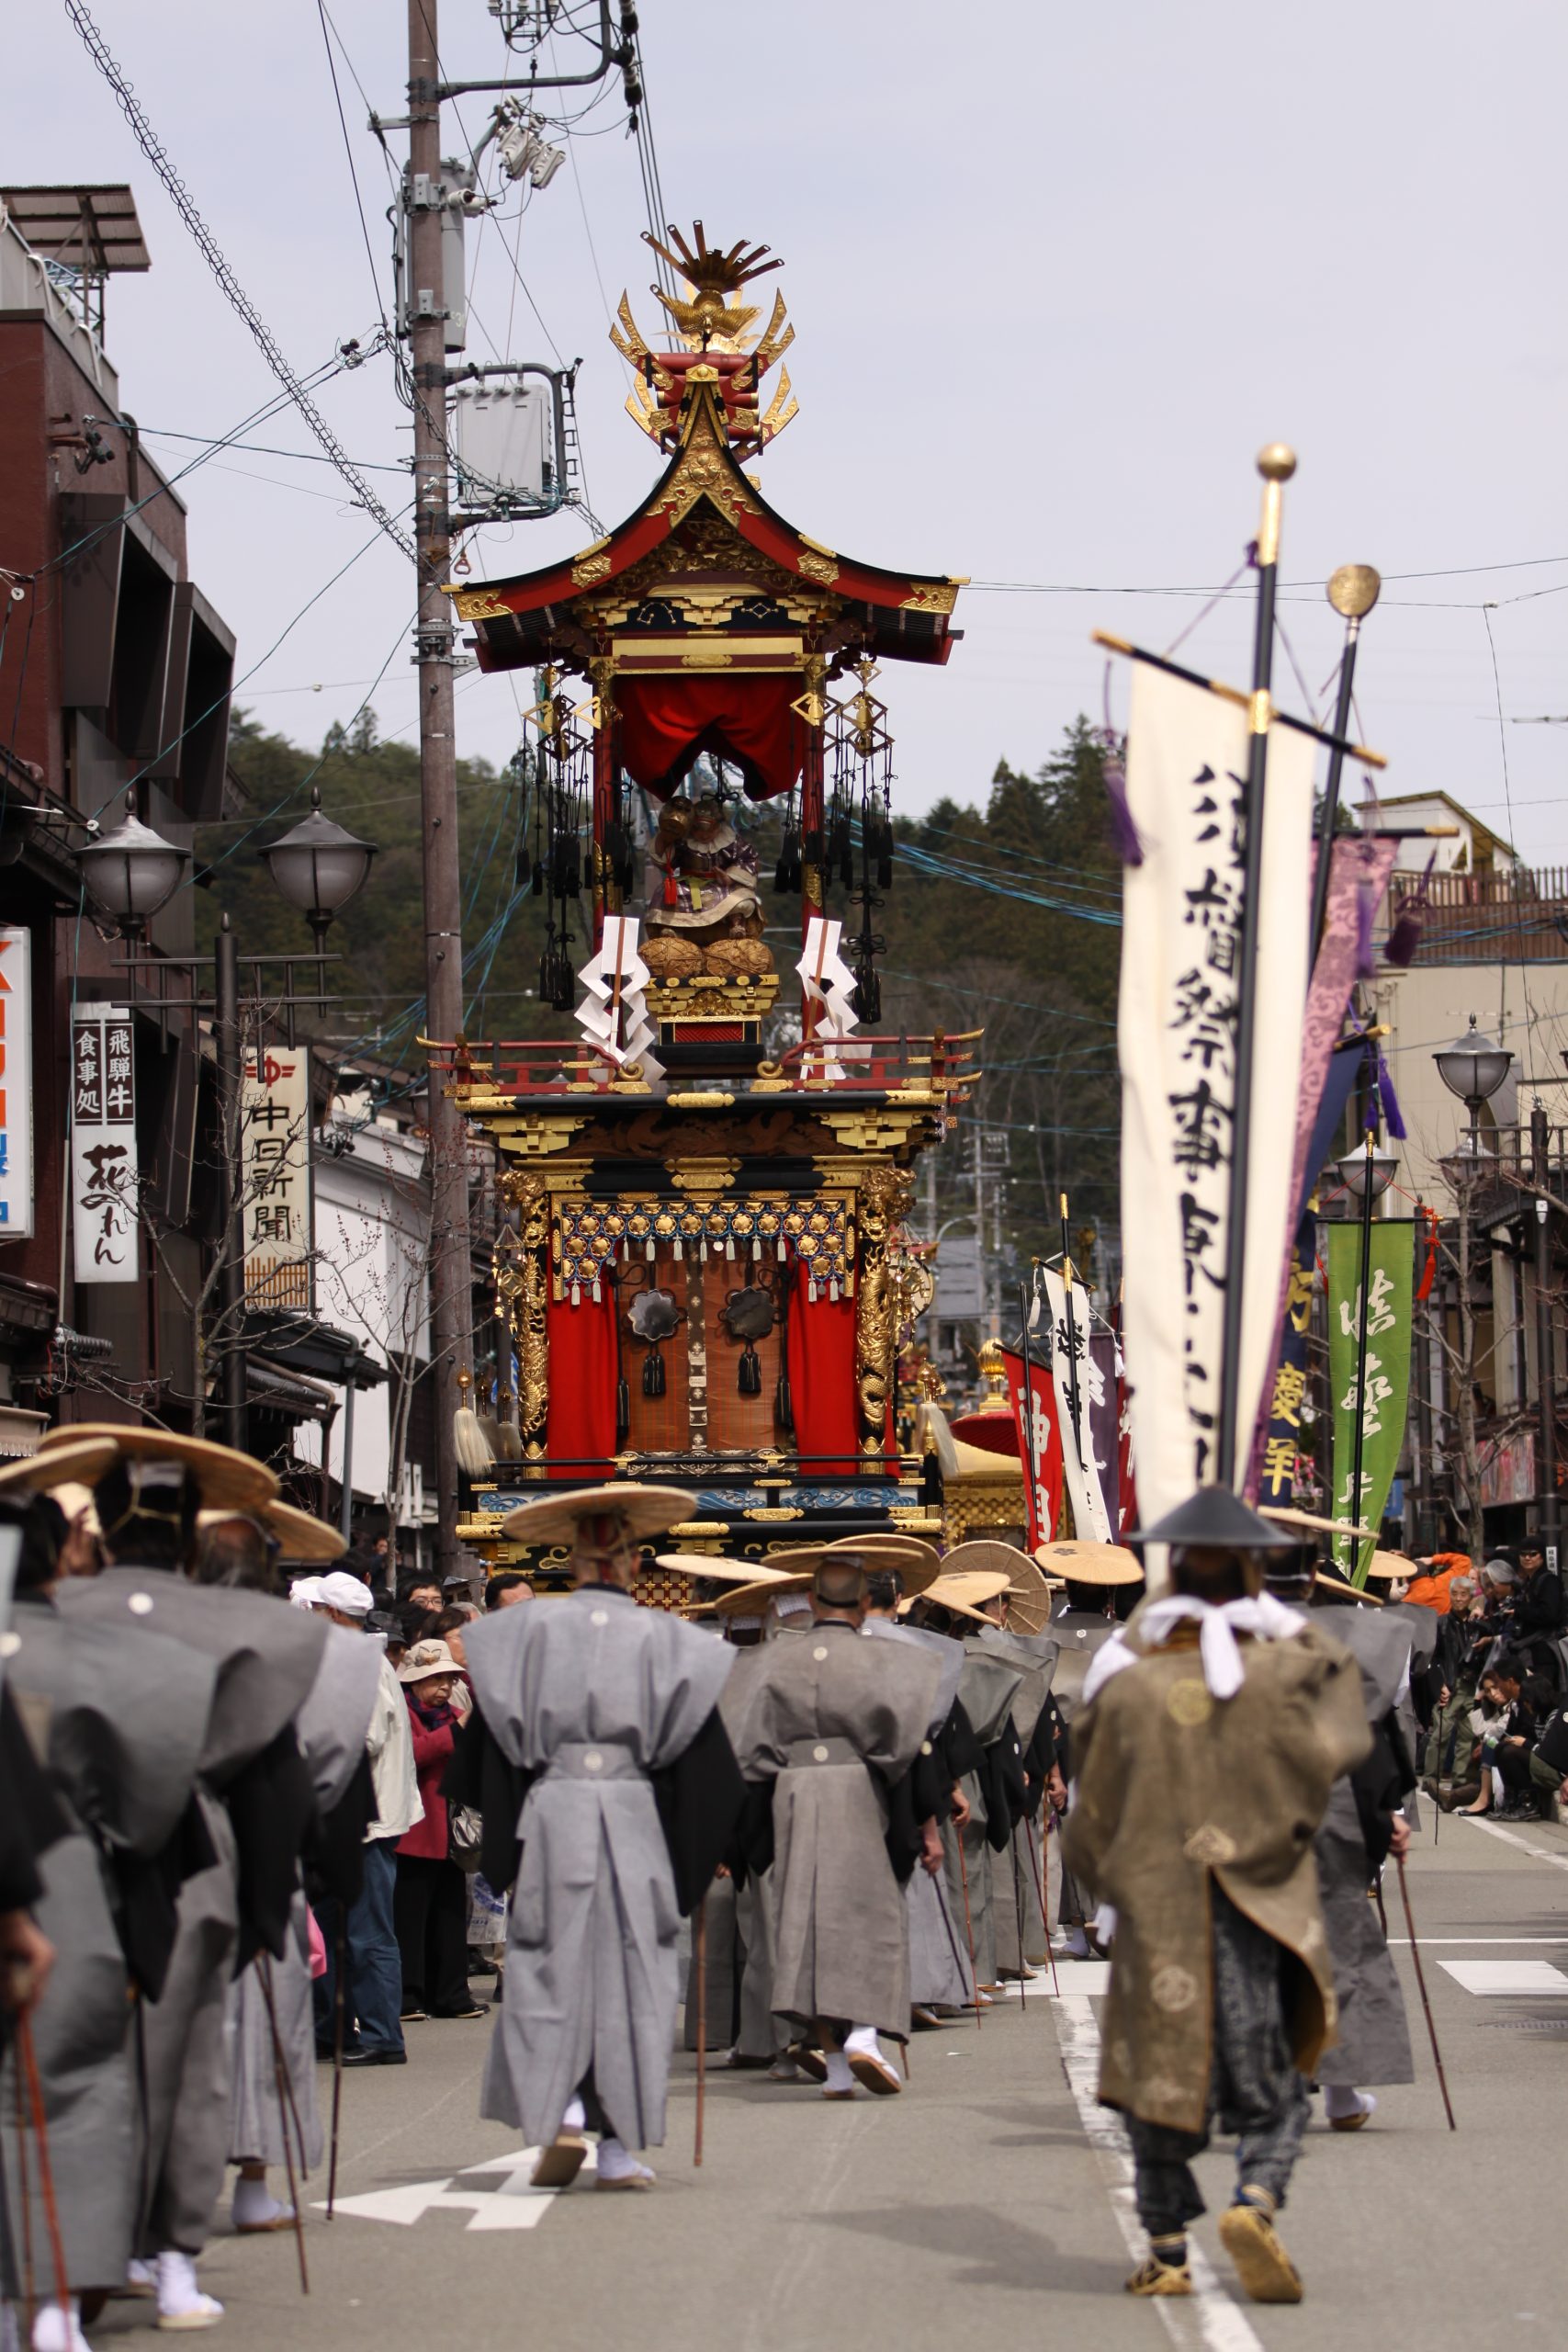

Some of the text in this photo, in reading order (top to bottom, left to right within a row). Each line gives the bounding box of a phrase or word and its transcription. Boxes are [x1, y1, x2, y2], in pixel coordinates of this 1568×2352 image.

[74, 1029, 100, 1114] 食事処
[107, 1028, 133, 1117] 飛騨牛
[79, 1143, 129, 1266] 花のれん
[251, 1096, 294, 1242] 中日新聞
